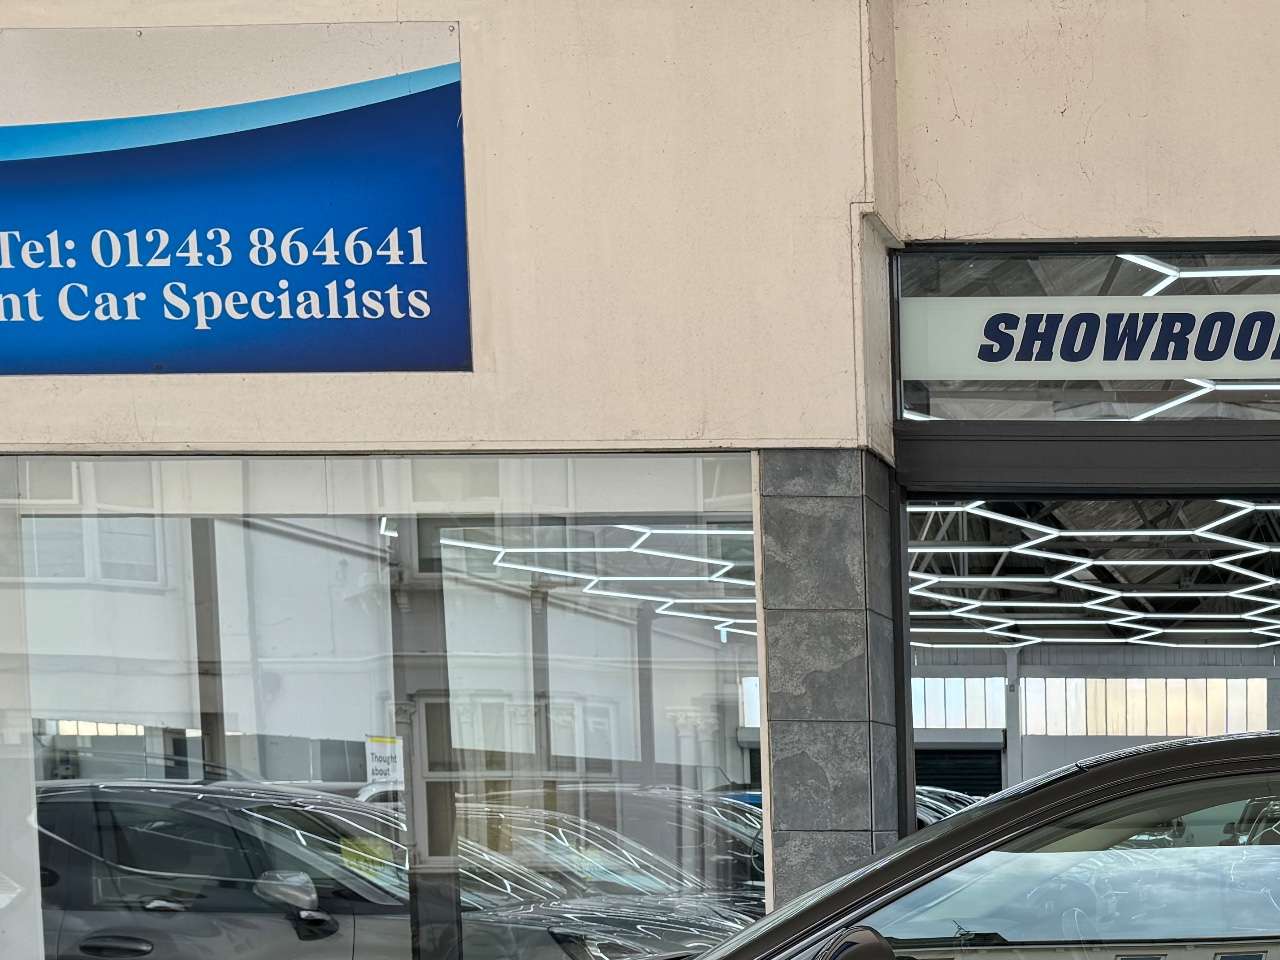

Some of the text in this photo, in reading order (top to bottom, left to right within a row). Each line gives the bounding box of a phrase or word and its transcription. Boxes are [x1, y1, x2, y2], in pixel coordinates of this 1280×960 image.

[0, 226, 428, 269] Tel: 01243 864641
[58, 282, 147, 322] Car
[162, 278, 431, 330] Specialists
[370, 752, 398, 766] Thought
